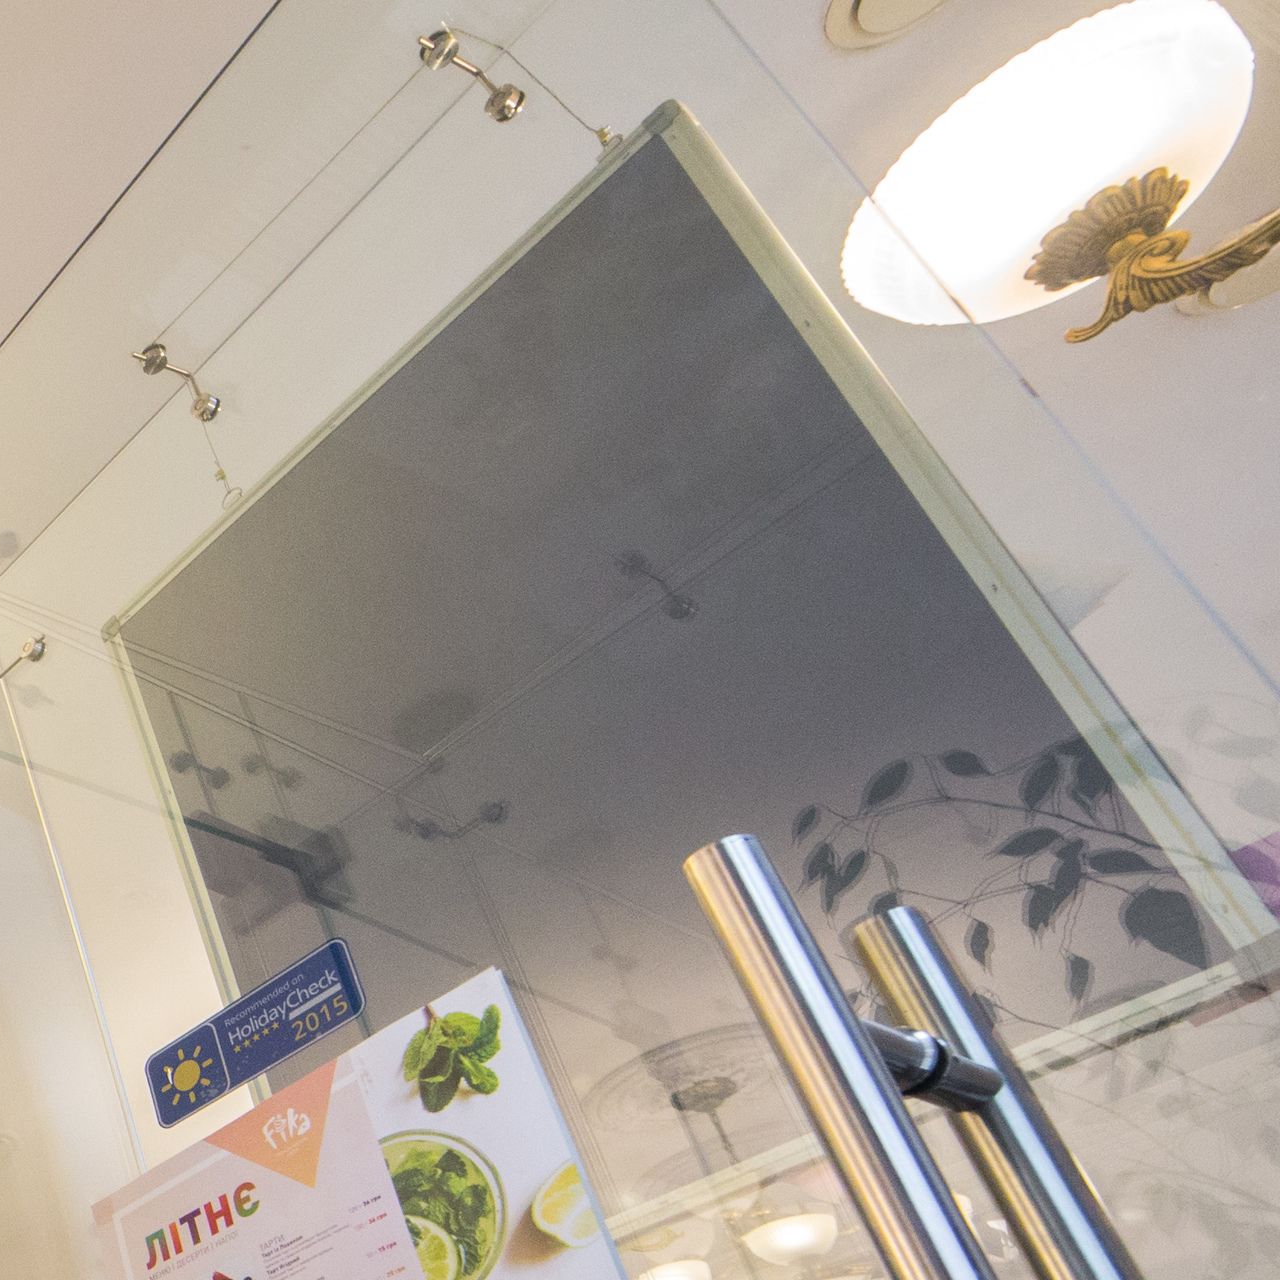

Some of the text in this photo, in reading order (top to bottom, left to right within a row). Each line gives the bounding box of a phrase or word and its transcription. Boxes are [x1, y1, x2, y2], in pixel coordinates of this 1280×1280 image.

[228, 970, 339, 1045] HolidayCheck
[292, 994, 348, 1041] 2015
[145, 1182, 260, 1271] ЛІТНЄ
